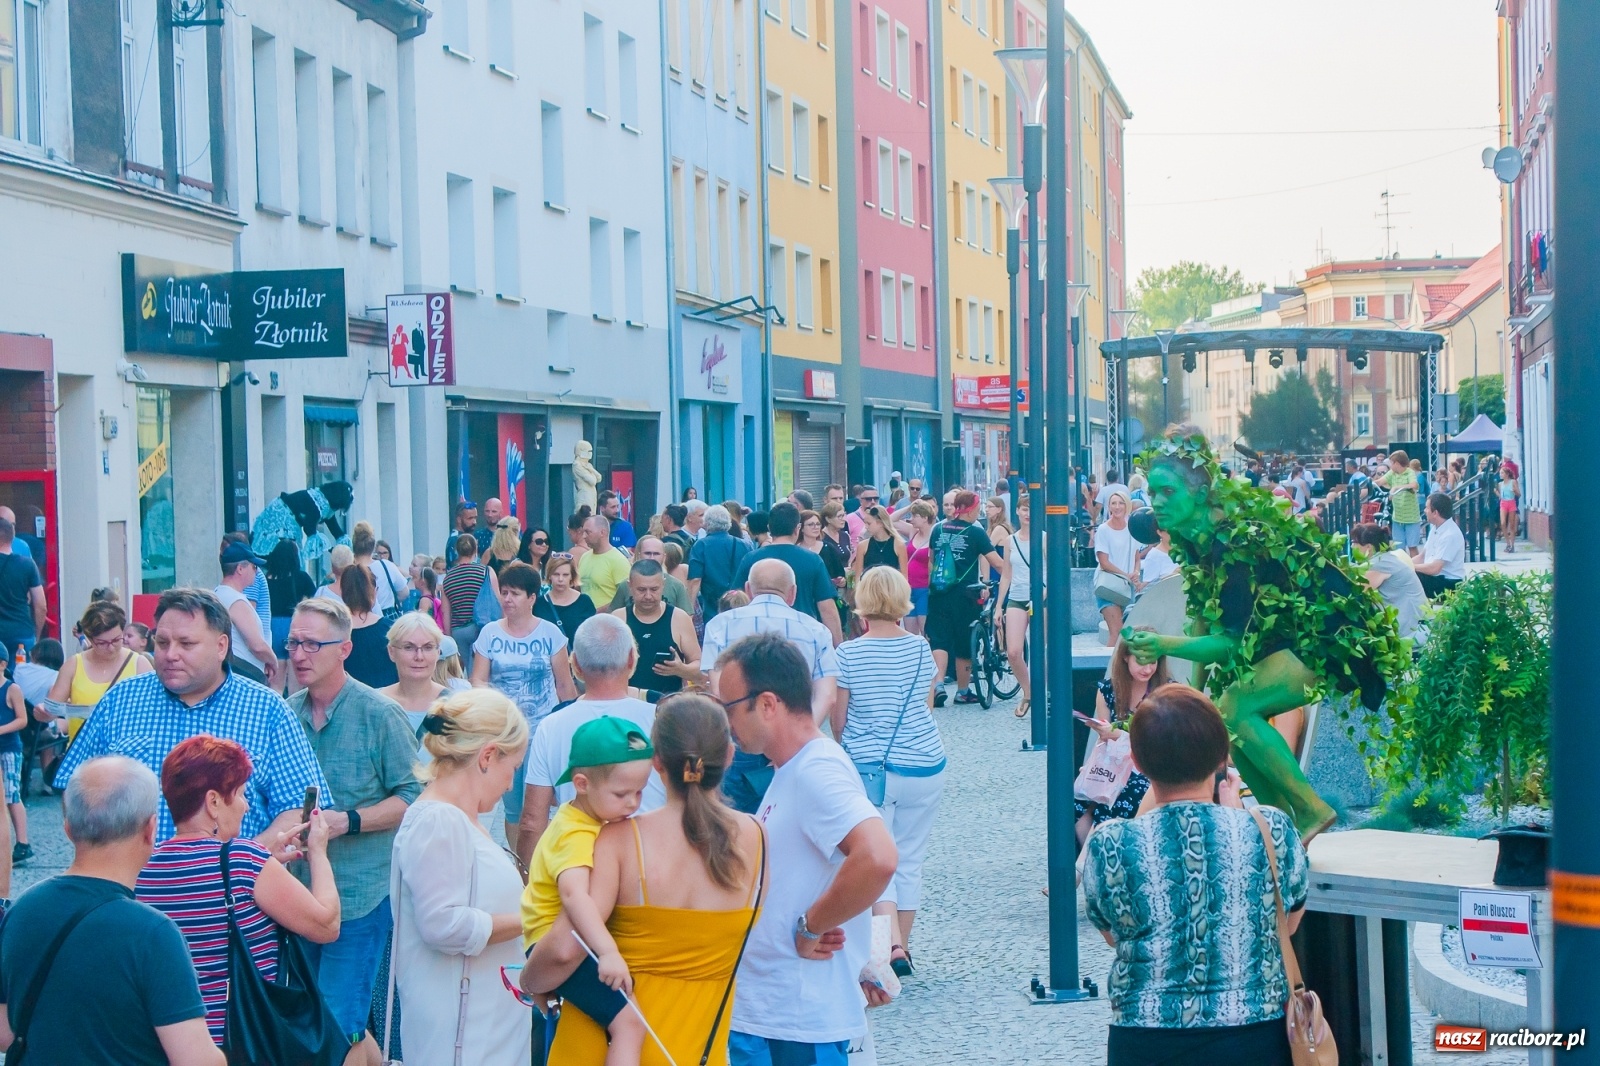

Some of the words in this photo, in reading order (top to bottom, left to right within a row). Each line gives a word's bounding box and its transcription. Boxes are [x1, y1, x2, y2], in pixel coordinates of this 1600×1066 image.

[165, 277, 200, 338] Jubiler
[253, 286, 326, 318] Jubiler
[254, 321, 329, 348] Złotnik
[1089, 764, 1117, 783] sinsay
[1473, 903, 1489, 917] Pani
[1490, 903, 1517, 919] Bluszcz
